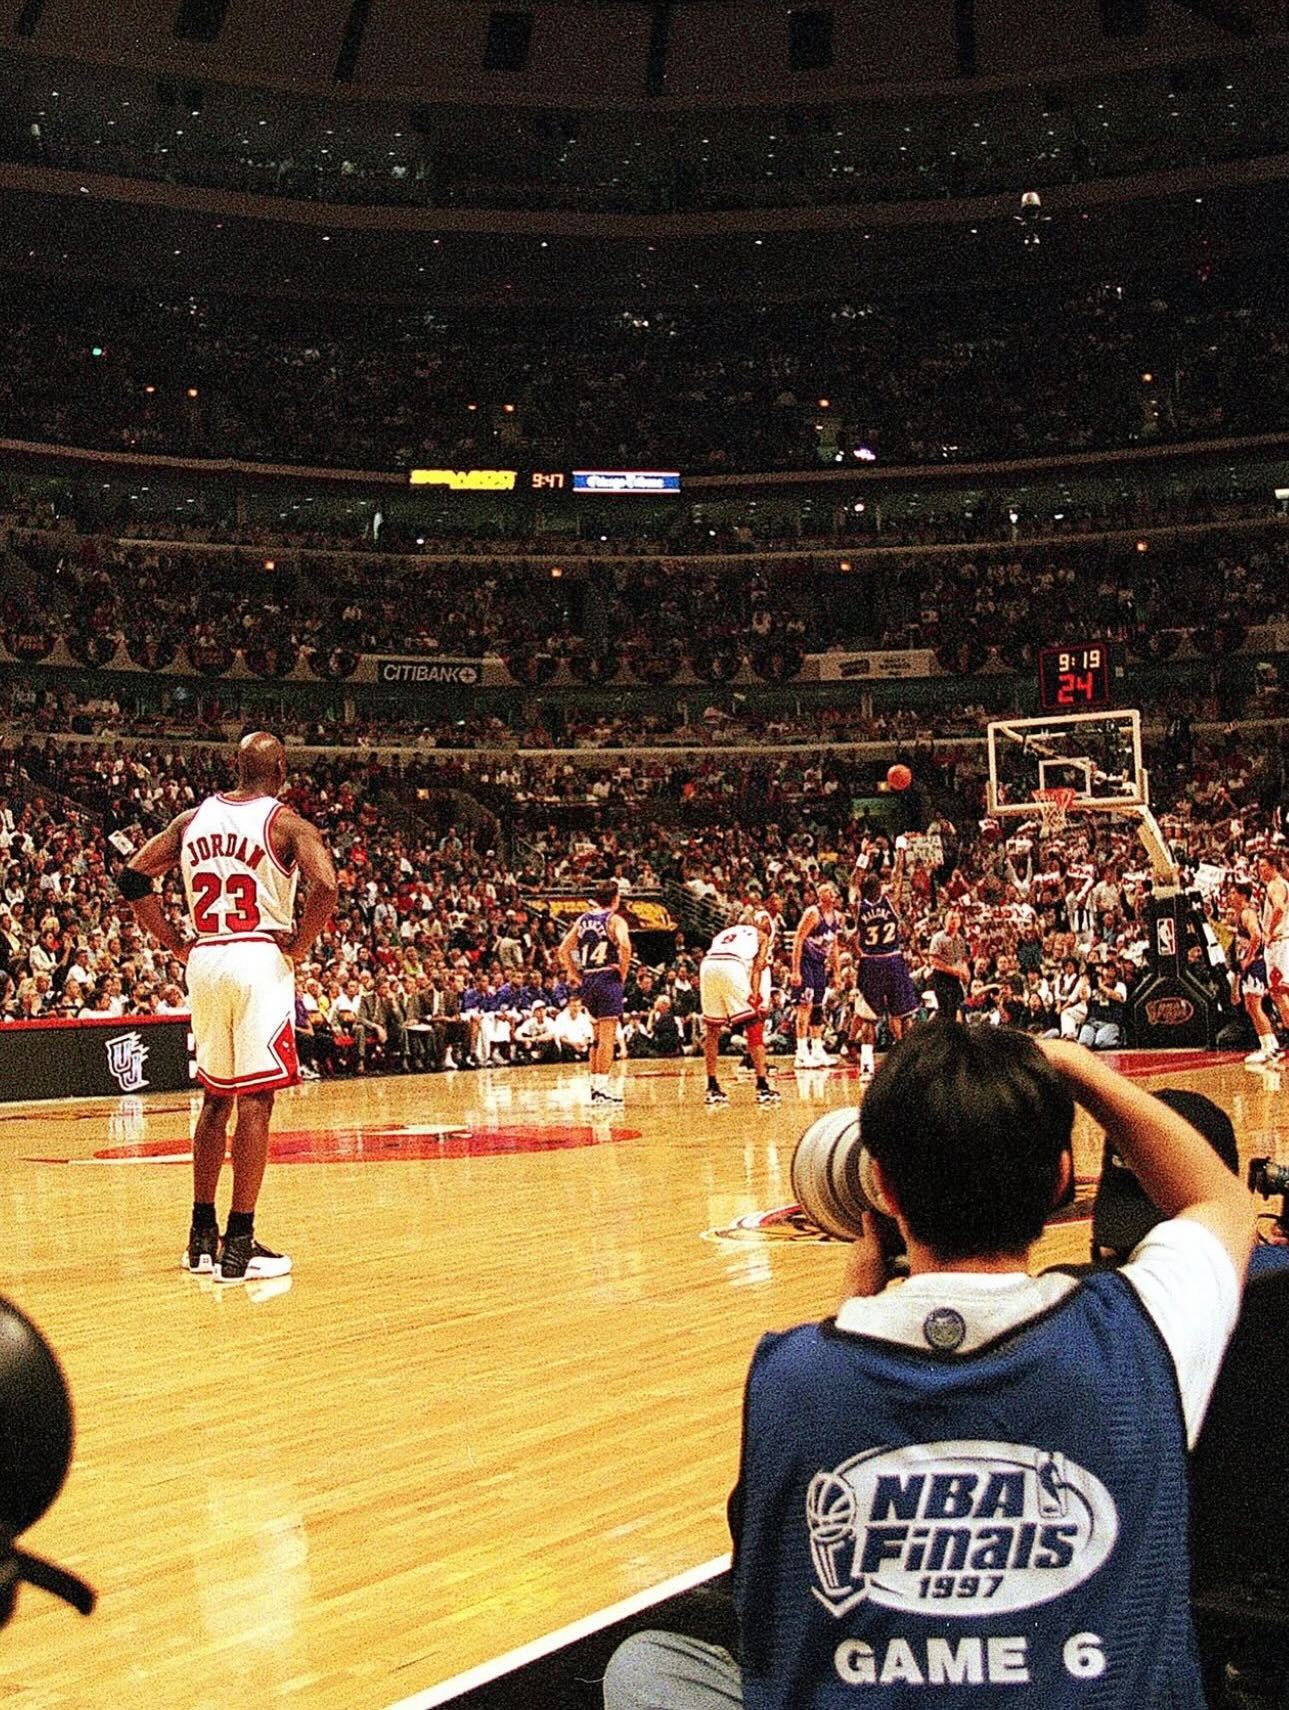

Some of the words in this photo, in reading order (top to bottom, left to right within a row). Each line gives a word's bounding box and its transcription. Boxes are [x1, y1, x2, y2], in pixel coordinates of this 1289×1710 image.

[532, 473, 563, 488] 9:47
[383, 663, 460, 682] CITIBANK
[1059, 649, 1100, 672] 9:19
[1057, 672, 1093, 704] 24
[187, 832, 266, 871] JORDAN
[192, 872, 261, 933] 23
[865, 921, 896, 945] 32
[581, 941, 609, 967] 14
[868, 1471, 1026, 1522] NBA
[860, 1522, 1079, 1573] Finals
[918, 1575, 1005, 1600] 1997
[833, 1638, 1030, 1685] GAME
[1063, 1632, 1107, 1679] 6
